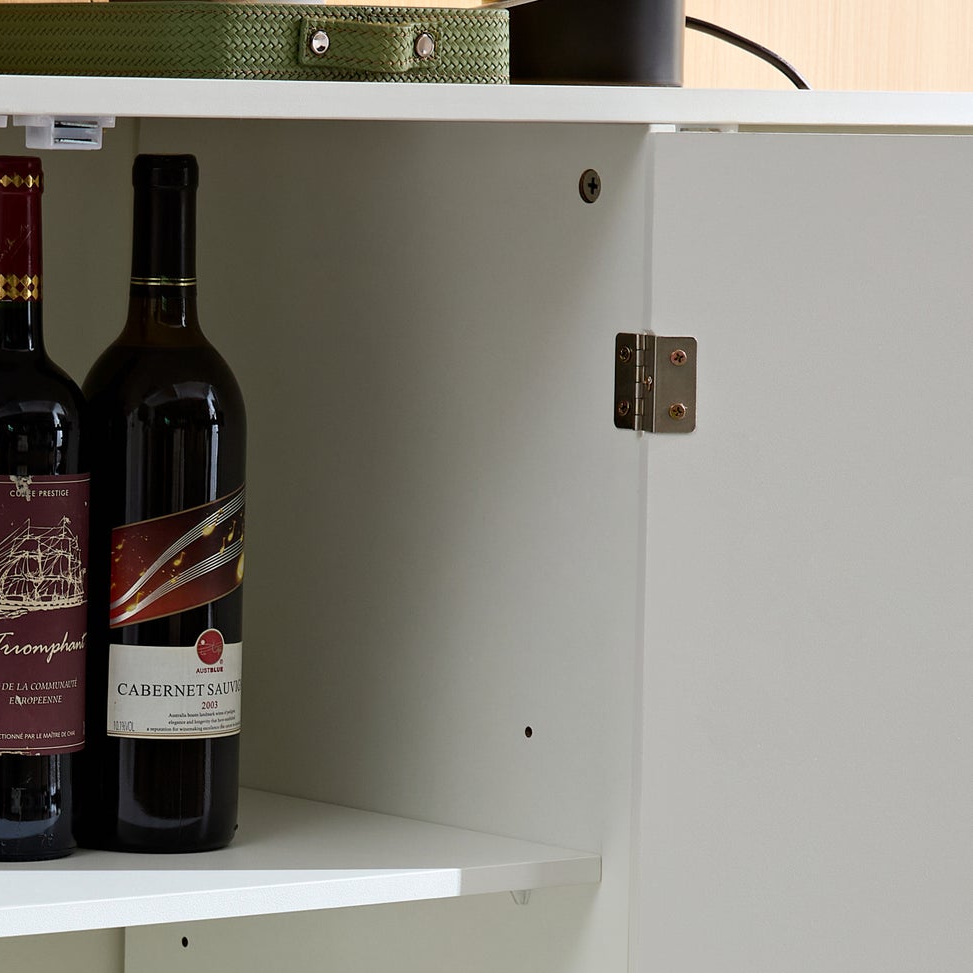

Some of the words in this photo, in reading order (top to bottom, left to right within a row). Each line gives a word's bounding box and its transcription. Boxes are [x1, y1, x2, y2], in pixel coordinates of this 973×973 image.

[38, 489, 69, 497] PRESTIGE
[195, 666, 224, 674] AUSTBLUE
[2, 682, 14, 691] DE
[16, 683, 28, 691] LA
[117, 682, 205, 697] CABERNET
[201, 700, 219, 710] 2003
[43, 731, 61, 739] MAÎTRE
